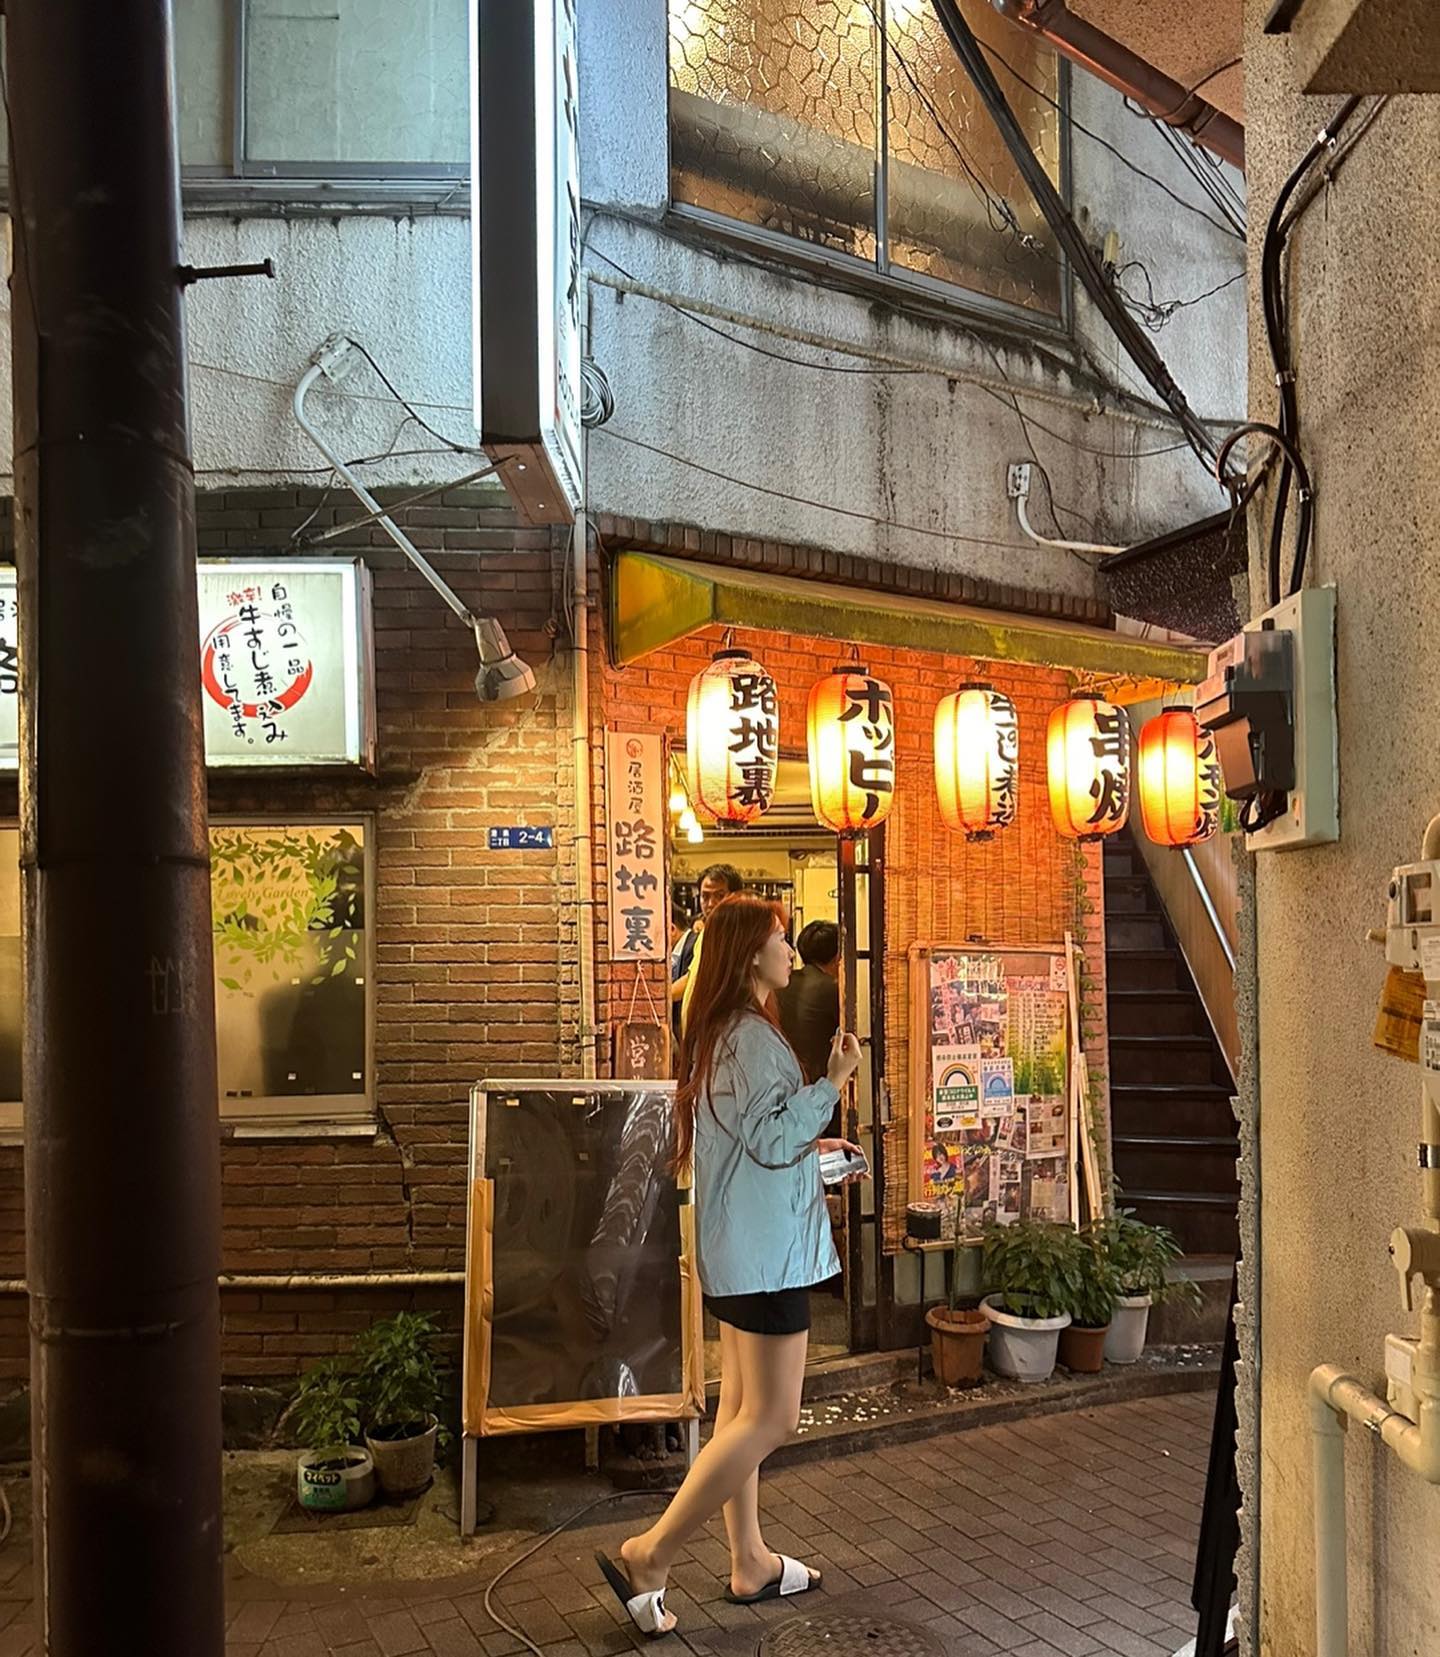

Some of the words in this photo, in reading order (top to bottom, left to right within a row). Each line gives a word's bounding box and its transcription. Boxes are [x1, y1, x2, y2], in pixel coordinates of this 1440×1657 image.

[239, 604, 288, 744] 牛すじ煮込み
[272, 583, 305, 675] 自慢の一品
[628, 761, 644, 814] 居酒屋
[728, 673, 778, 812] 路地裏
[519, 831, 544, 844] 2-4
[262, 887, 309, 899] Garden
[615, 818, 658, 952] 路地裏
